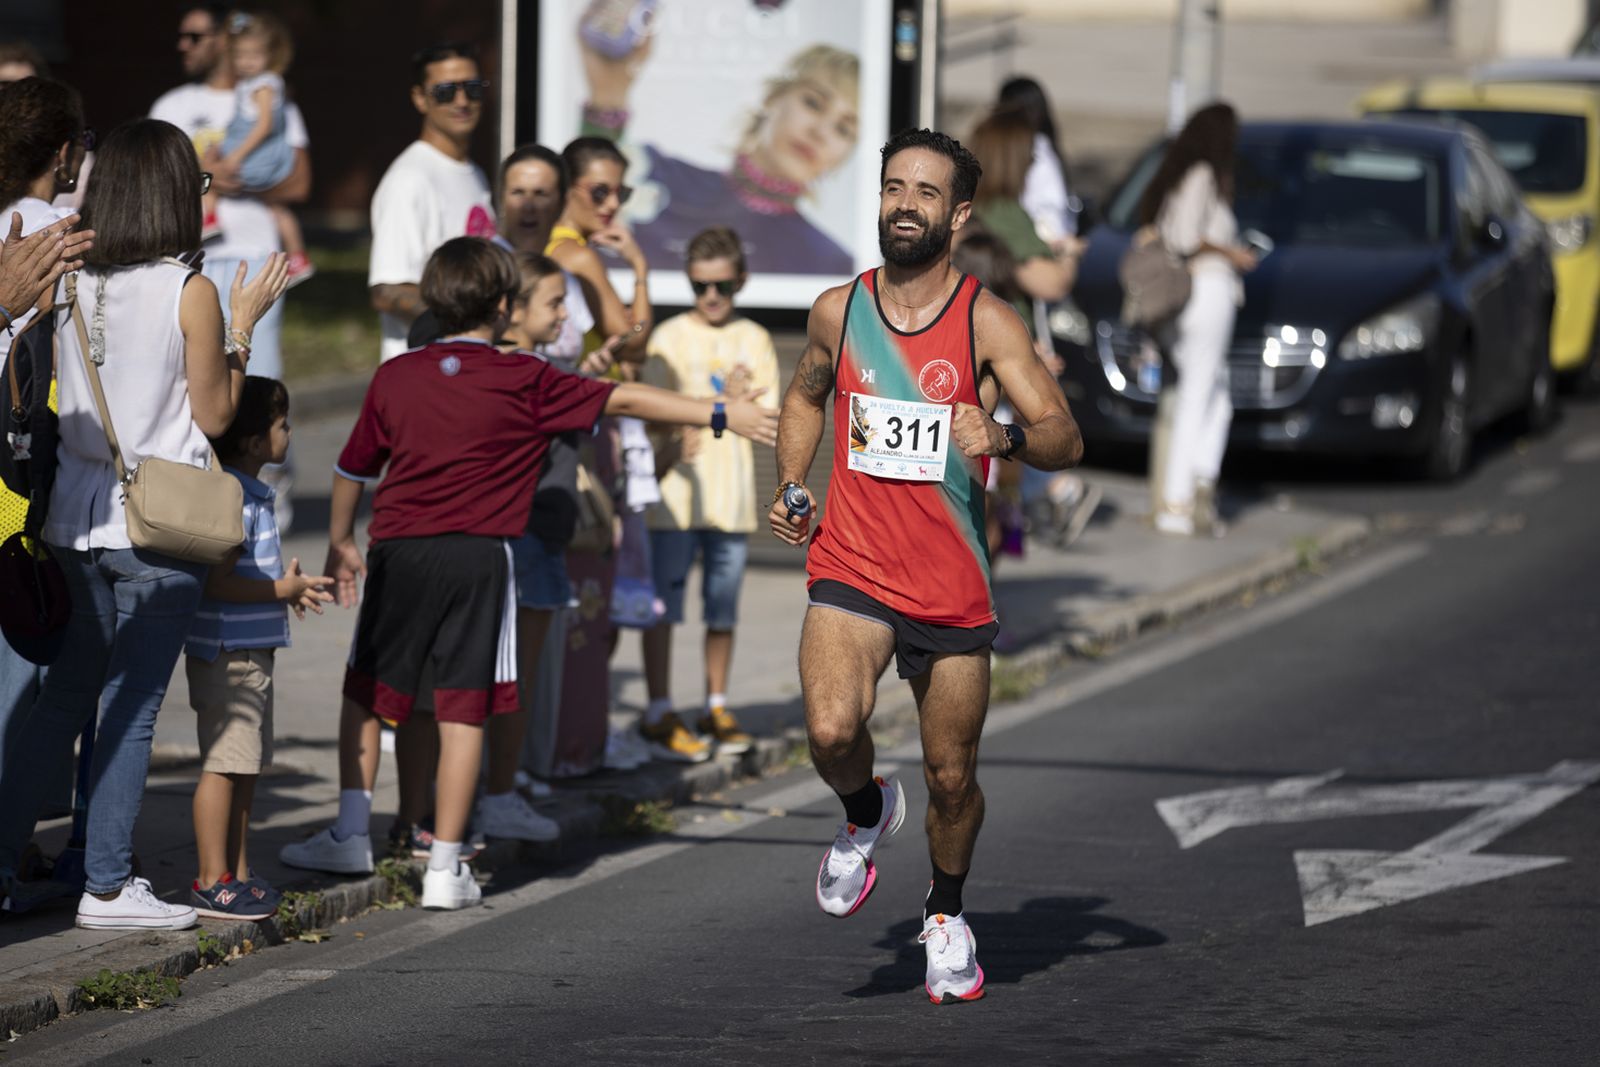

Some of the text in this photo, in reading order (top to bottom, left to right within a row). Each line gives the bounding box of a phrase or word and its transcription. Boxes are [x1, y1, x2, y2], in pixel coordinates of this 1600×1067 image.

[879, 402, 905, 411] VUELTA
[916, 407, 943, 415] HUELVA
[885, 416, 940, 452] 311
[870, 448, 902, 457] ALEJANDRO
[214, 888, 237, 905] N
